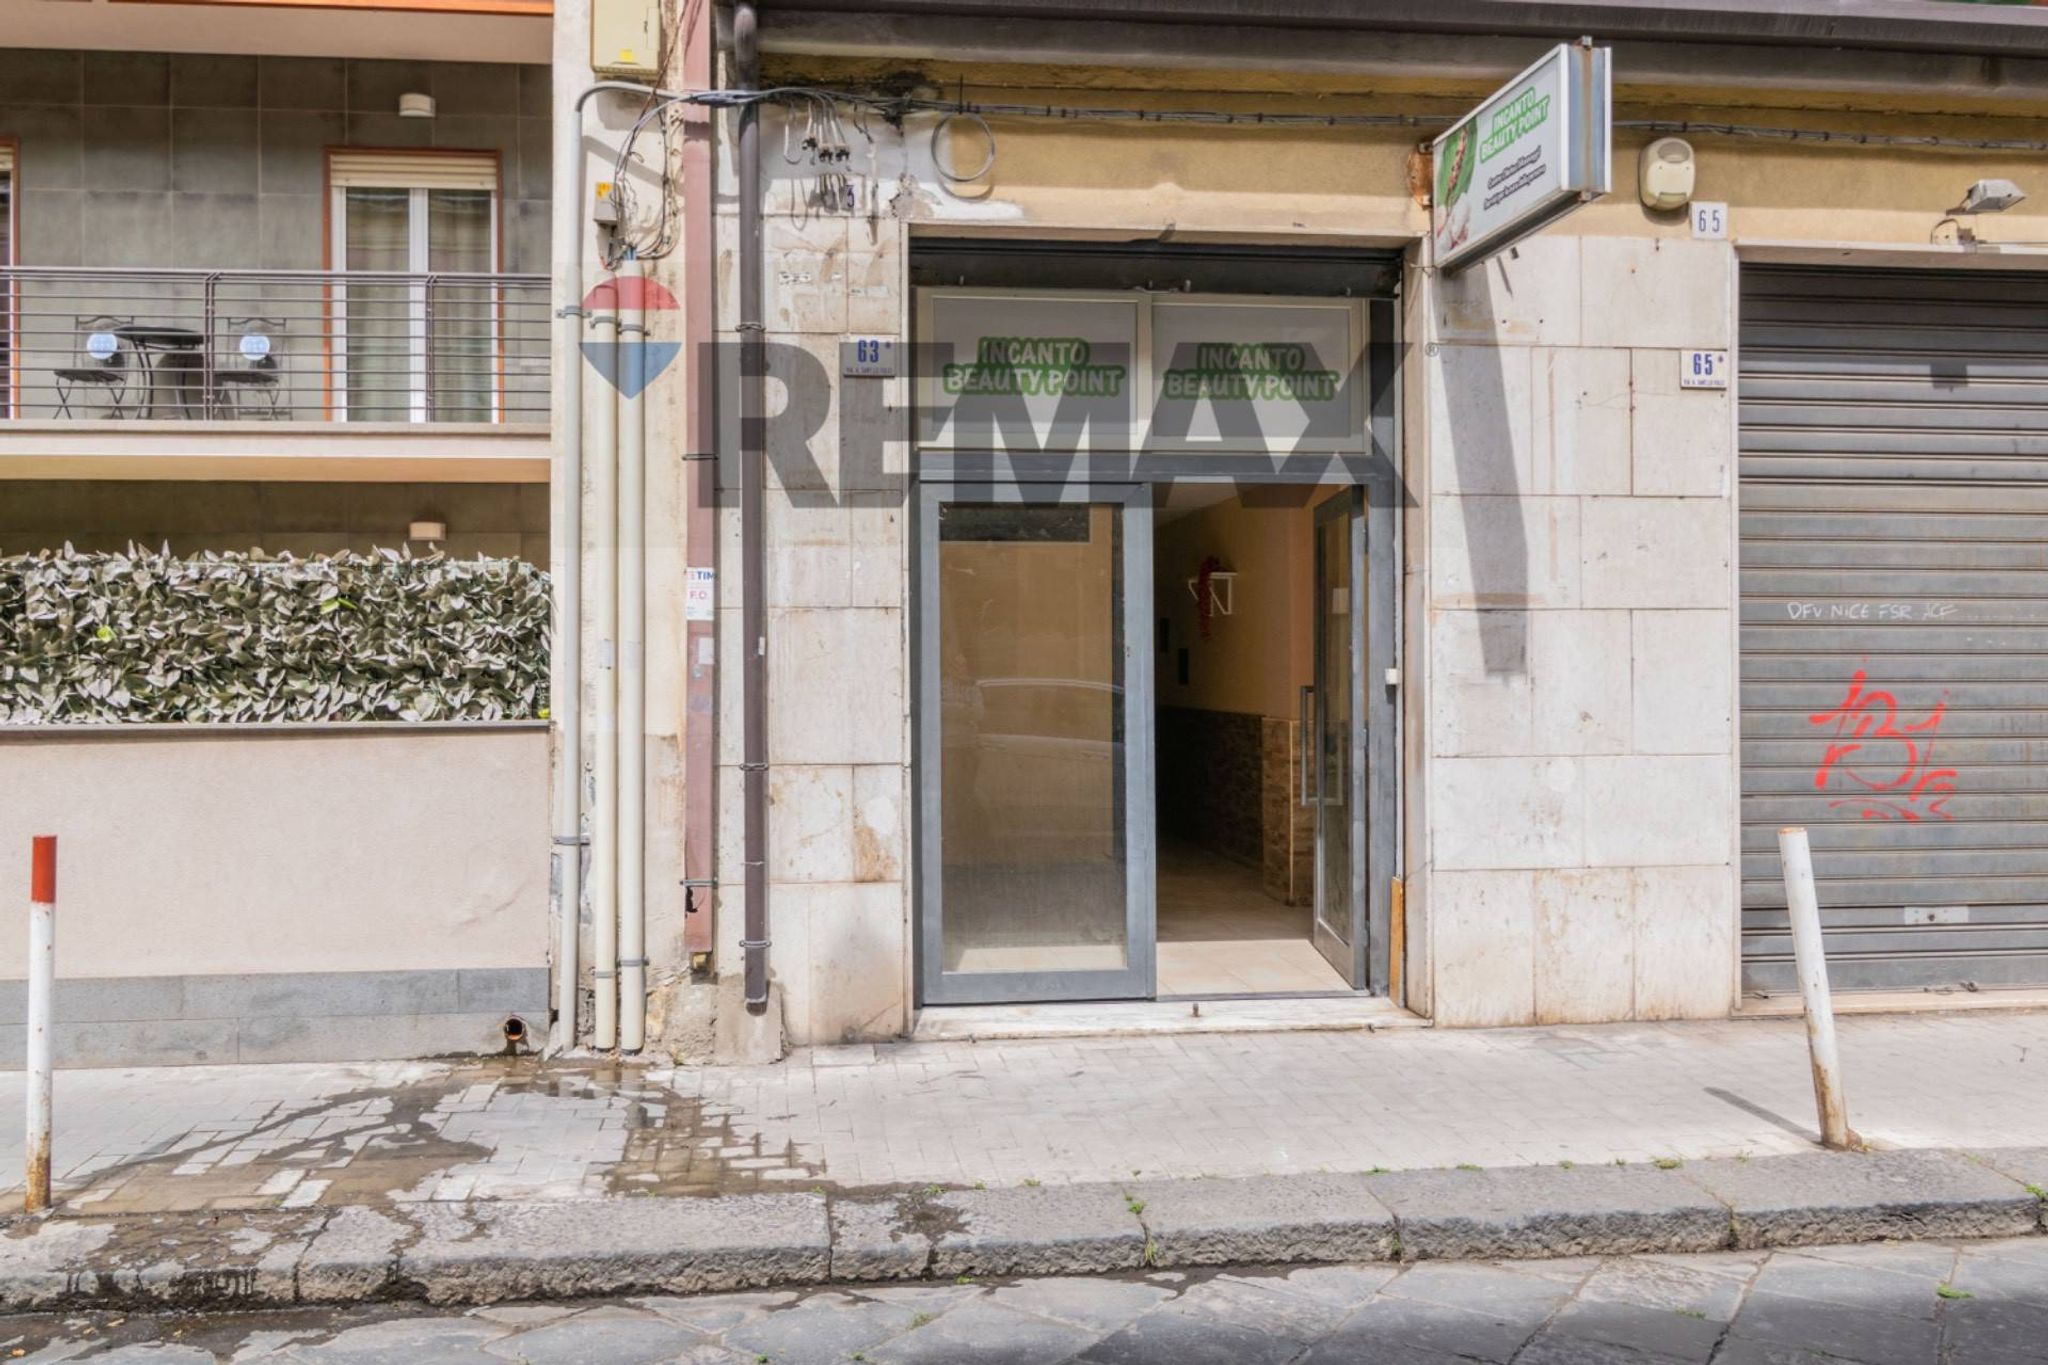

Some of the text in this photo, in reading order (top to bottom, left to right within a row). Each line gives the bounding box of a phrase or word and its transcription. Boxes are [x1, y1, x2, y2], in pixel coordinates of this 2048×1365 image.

[1699, 209, 1720, 232] 65
[858, 339, 879, 363] 63
[979, 341, 1086, 364] INCANTO
[1201, 347, 1300, 370] INCANTO
[1693, 353, 1713, 375] 65
[948, 368, 1121, 393] BEAUTY POINT
[1168, 373, 1336, 397] BEAUTY POINT
